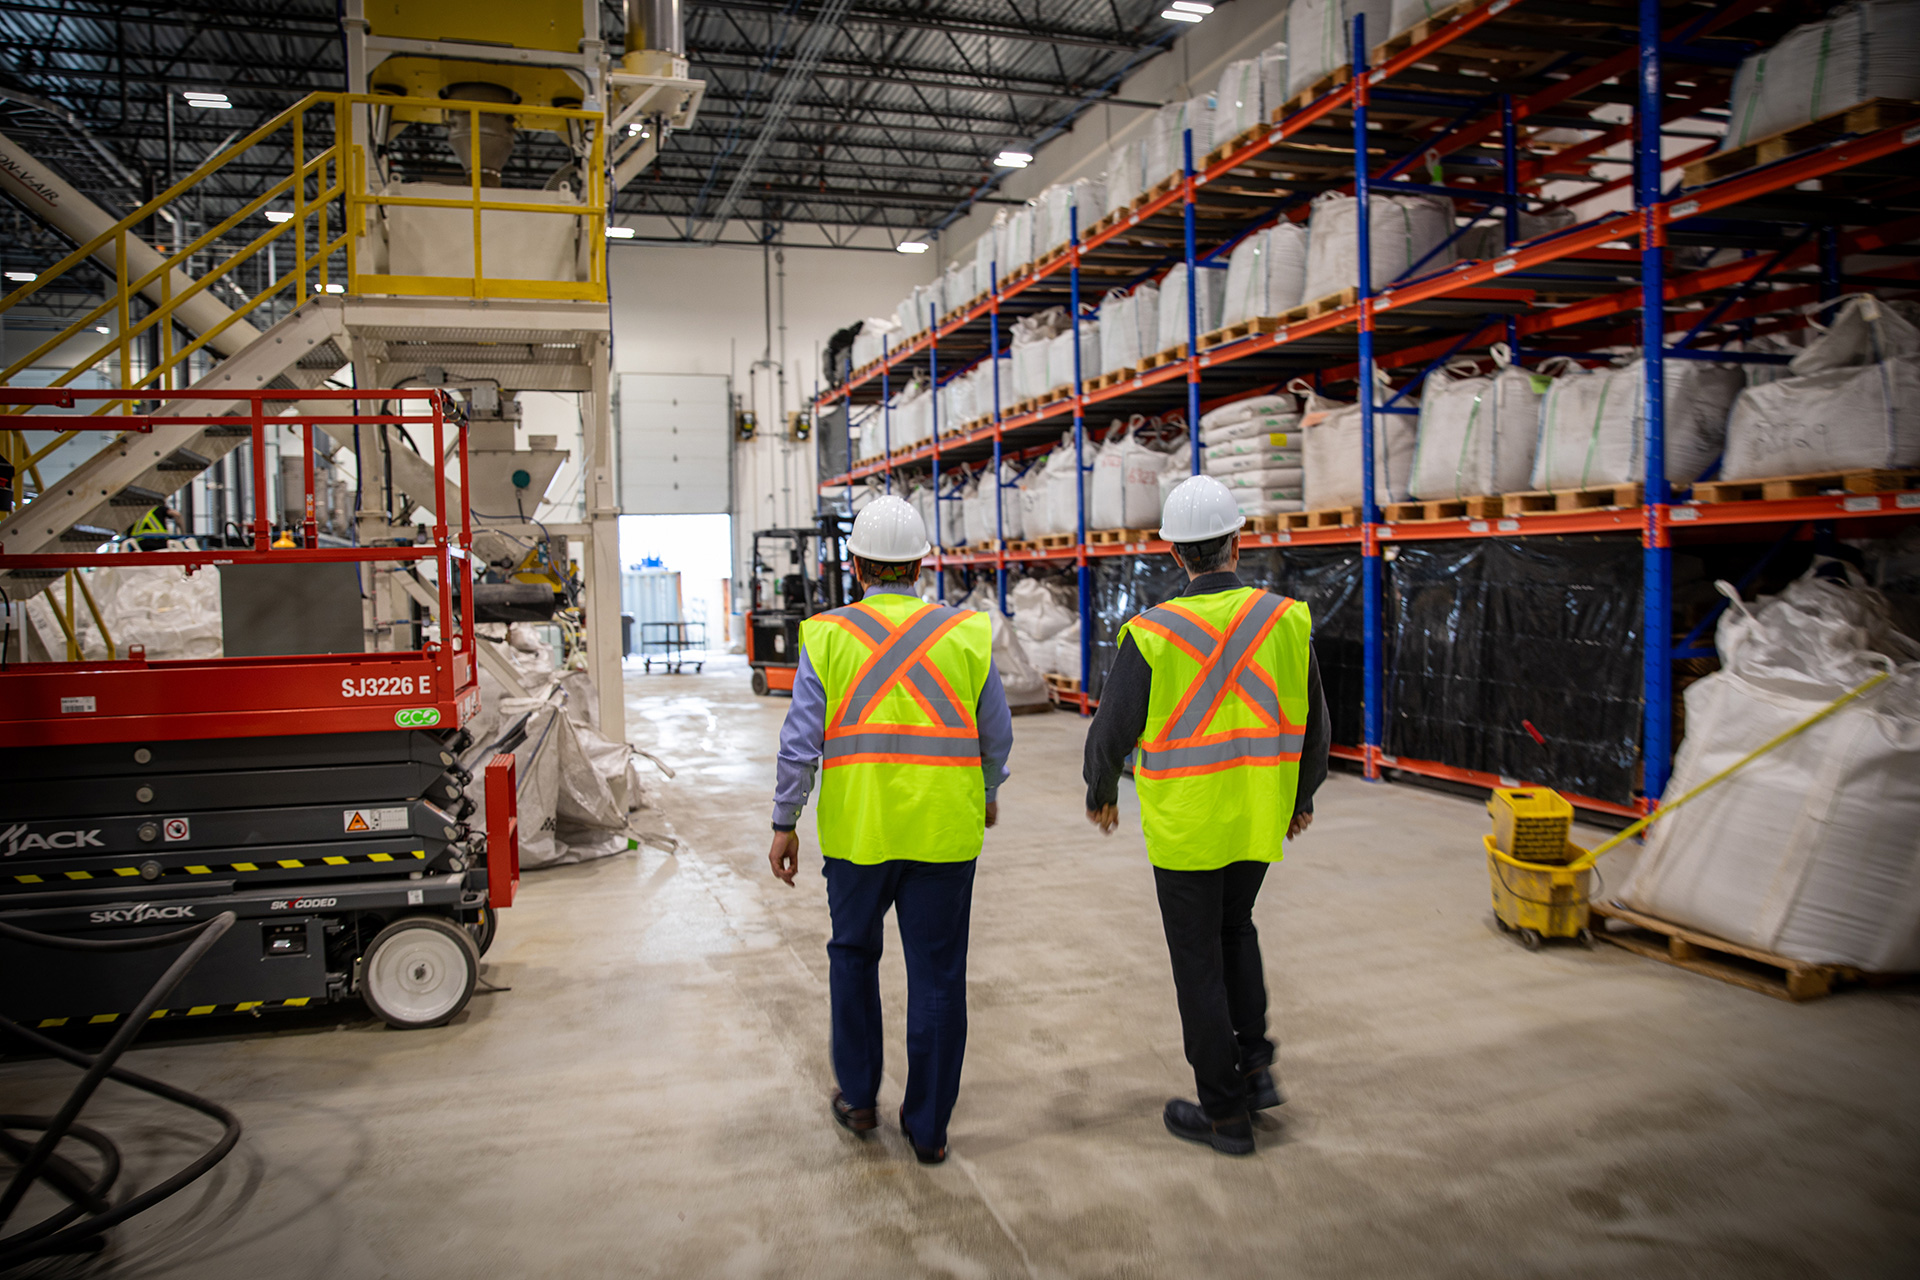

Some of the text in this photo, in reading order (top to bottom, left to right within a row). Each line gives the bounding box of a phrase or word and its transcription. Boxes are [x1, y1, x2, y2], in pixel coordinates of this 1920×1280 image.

[0, 151, 59, 201] ON-V-AIR
[341, 675, 431, 698] SJ3226 E
[89, 903, 196, 923] SKYJACK
[270, 896, 338, 910] SKYCODED
